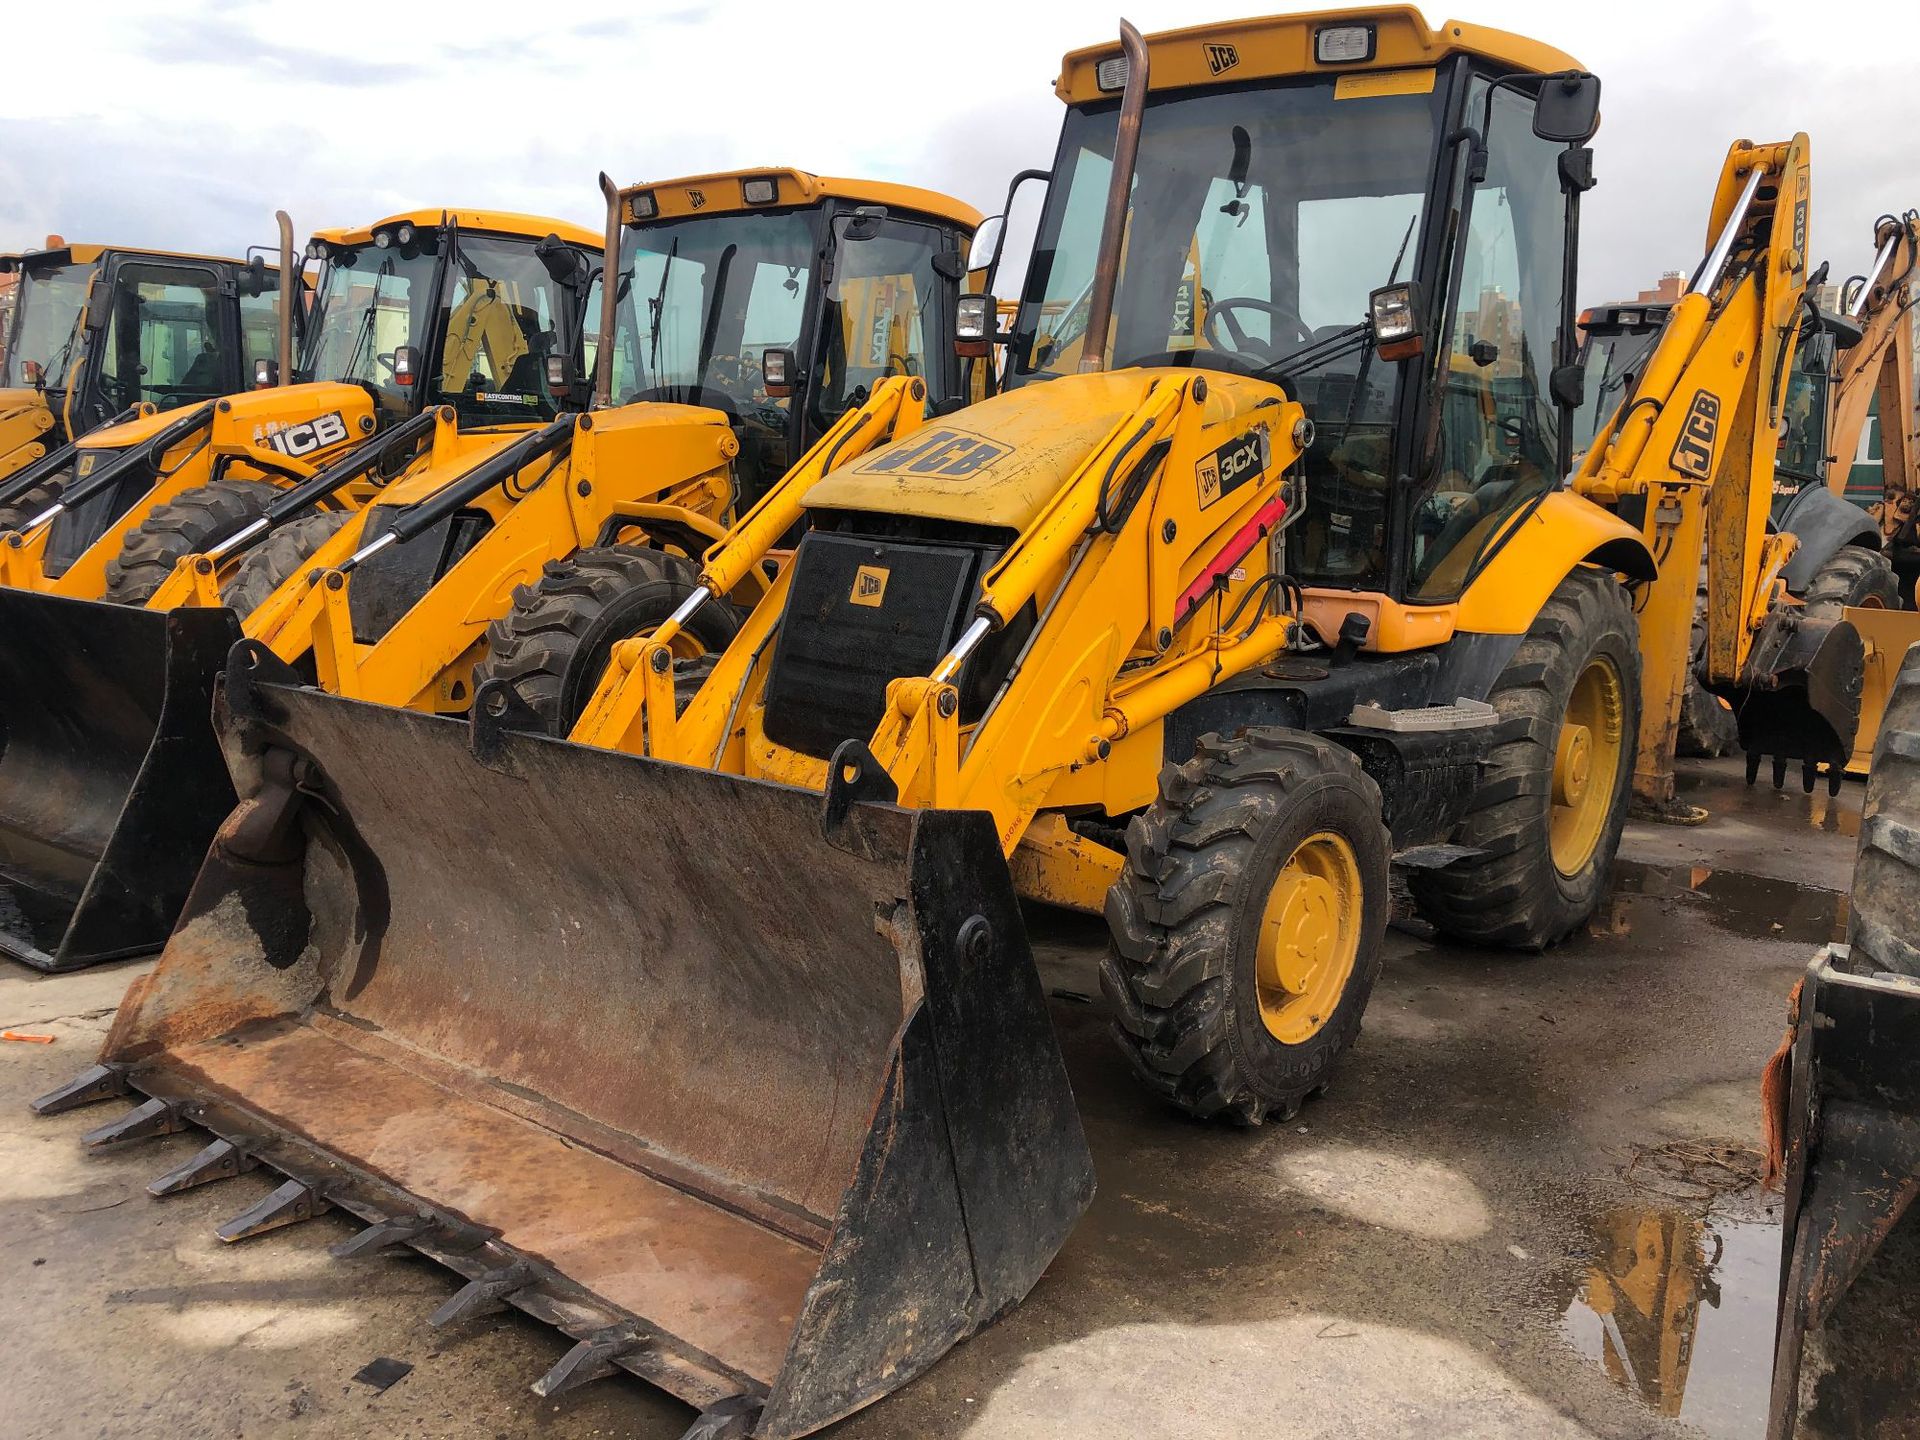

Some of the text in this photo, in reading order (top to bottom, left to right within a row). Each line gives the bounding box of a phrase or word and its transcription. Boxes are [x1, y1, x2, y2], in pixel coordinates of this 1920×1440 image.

[1209, 46, 1238, 72] JCB
[688, 191, 706, 208] JCB
[1173, 285, 1190, 331] 4CX
[484, 393, 522, 401] EASYCONTROL
[1678, 397, 1718, 472] JCB
[864, 431, 1002, 475] JCB
[1201, 439, 1259, 495] JCB 3CX
[860, 575, 880, 595] JCB
